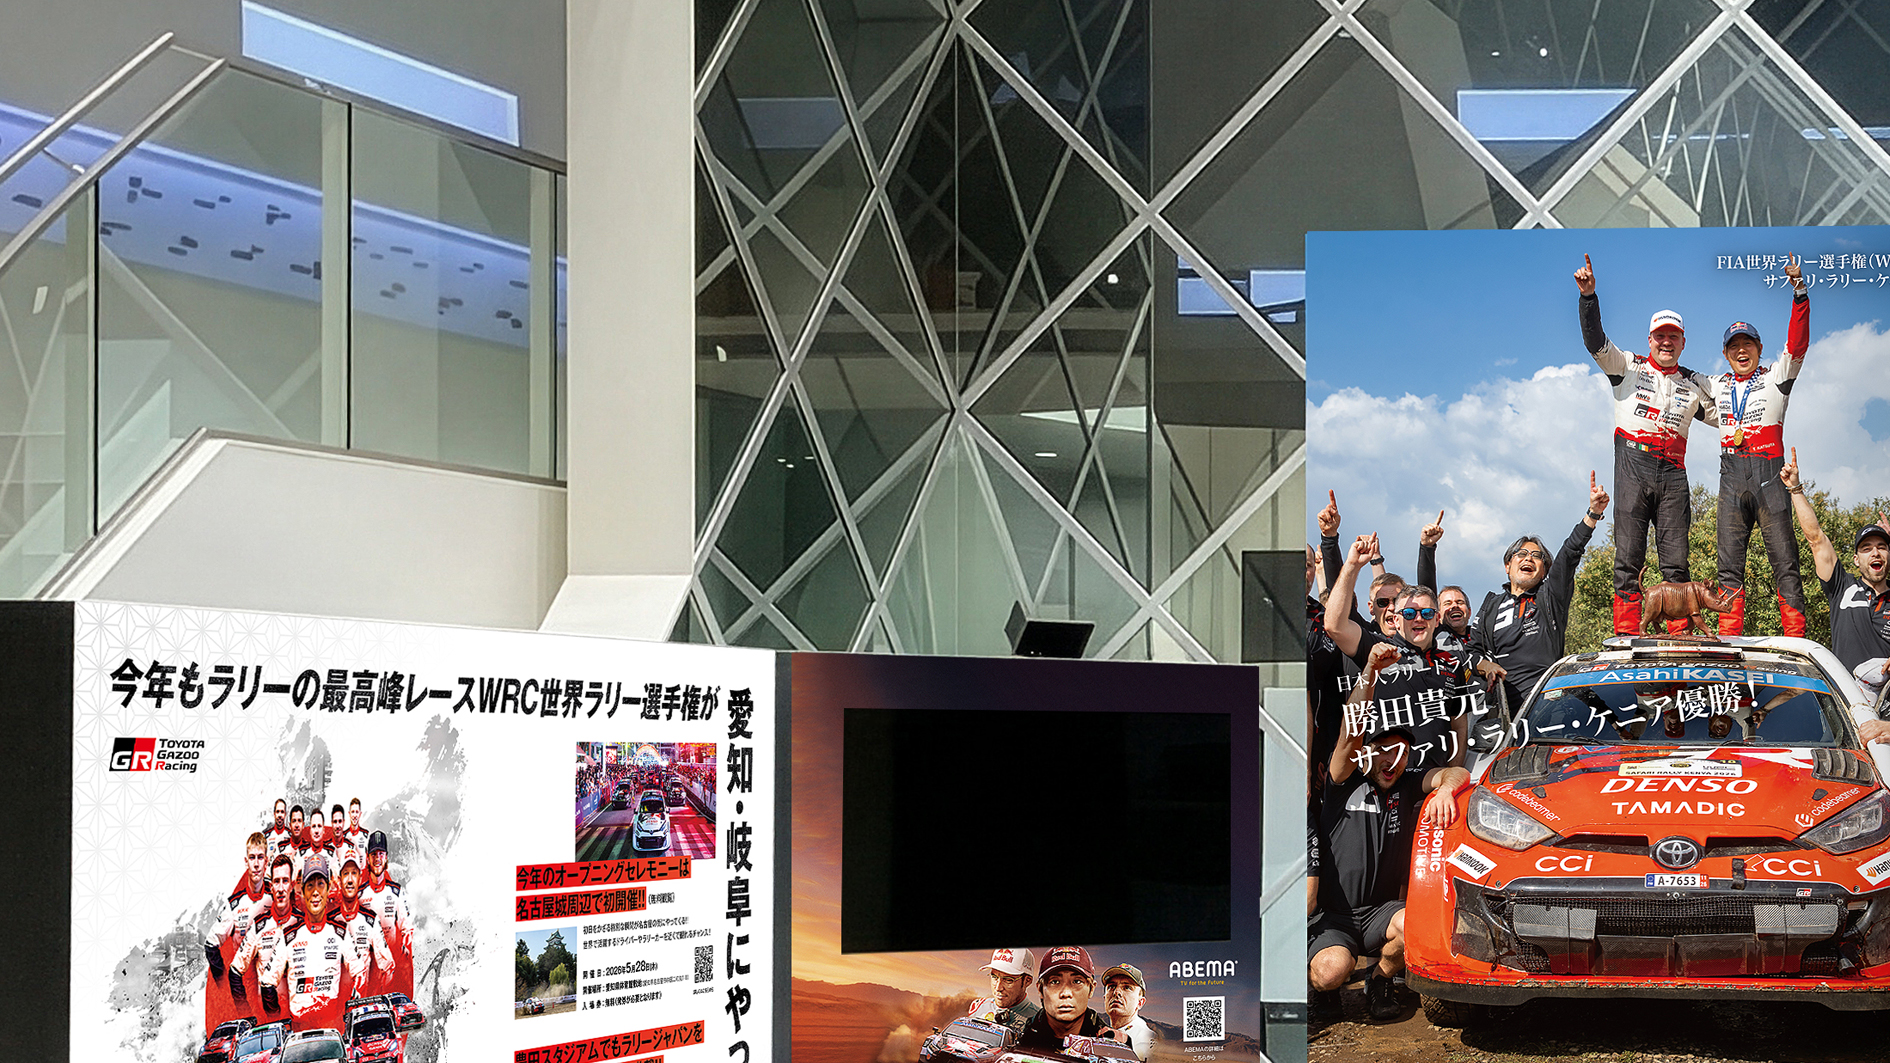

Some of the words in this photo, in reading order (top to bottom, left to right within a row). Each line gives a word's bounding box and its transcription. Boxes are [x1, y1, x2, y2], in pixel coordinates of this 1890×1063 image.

[1337, 653, 1510, 693] 日本人ラリードライバー
[1599, 668, 1775, 684] AsahiKASEI
[110, 657, 720, 722] 今年もラリーの最高峰レースWRC世界ラリー選手権が
[1342, 681, 1491, 738] 勝田貴元
[1349, 679, 1760, 776] サファリ・ラリー・ケニア優勝!
[159, 738, 205, 749] TOYOTA
[111, 750, 153, 770] GR
[157, 750, 200, 760] GAZOO
[154, 760, 198, 773] Racing
[1600, 777, 1759, 795] DENSO
[1611, 801, 1746, 818] TAMADIC
[516, 860, 690, 890] 今年のオープニングセレモニーは
[1656, 874, 1697, 887] A-7653
[516, 889, 646, 920] 名古屋城周辺で初開催!!
[1169, 959, 1236, 979] ABEMA
